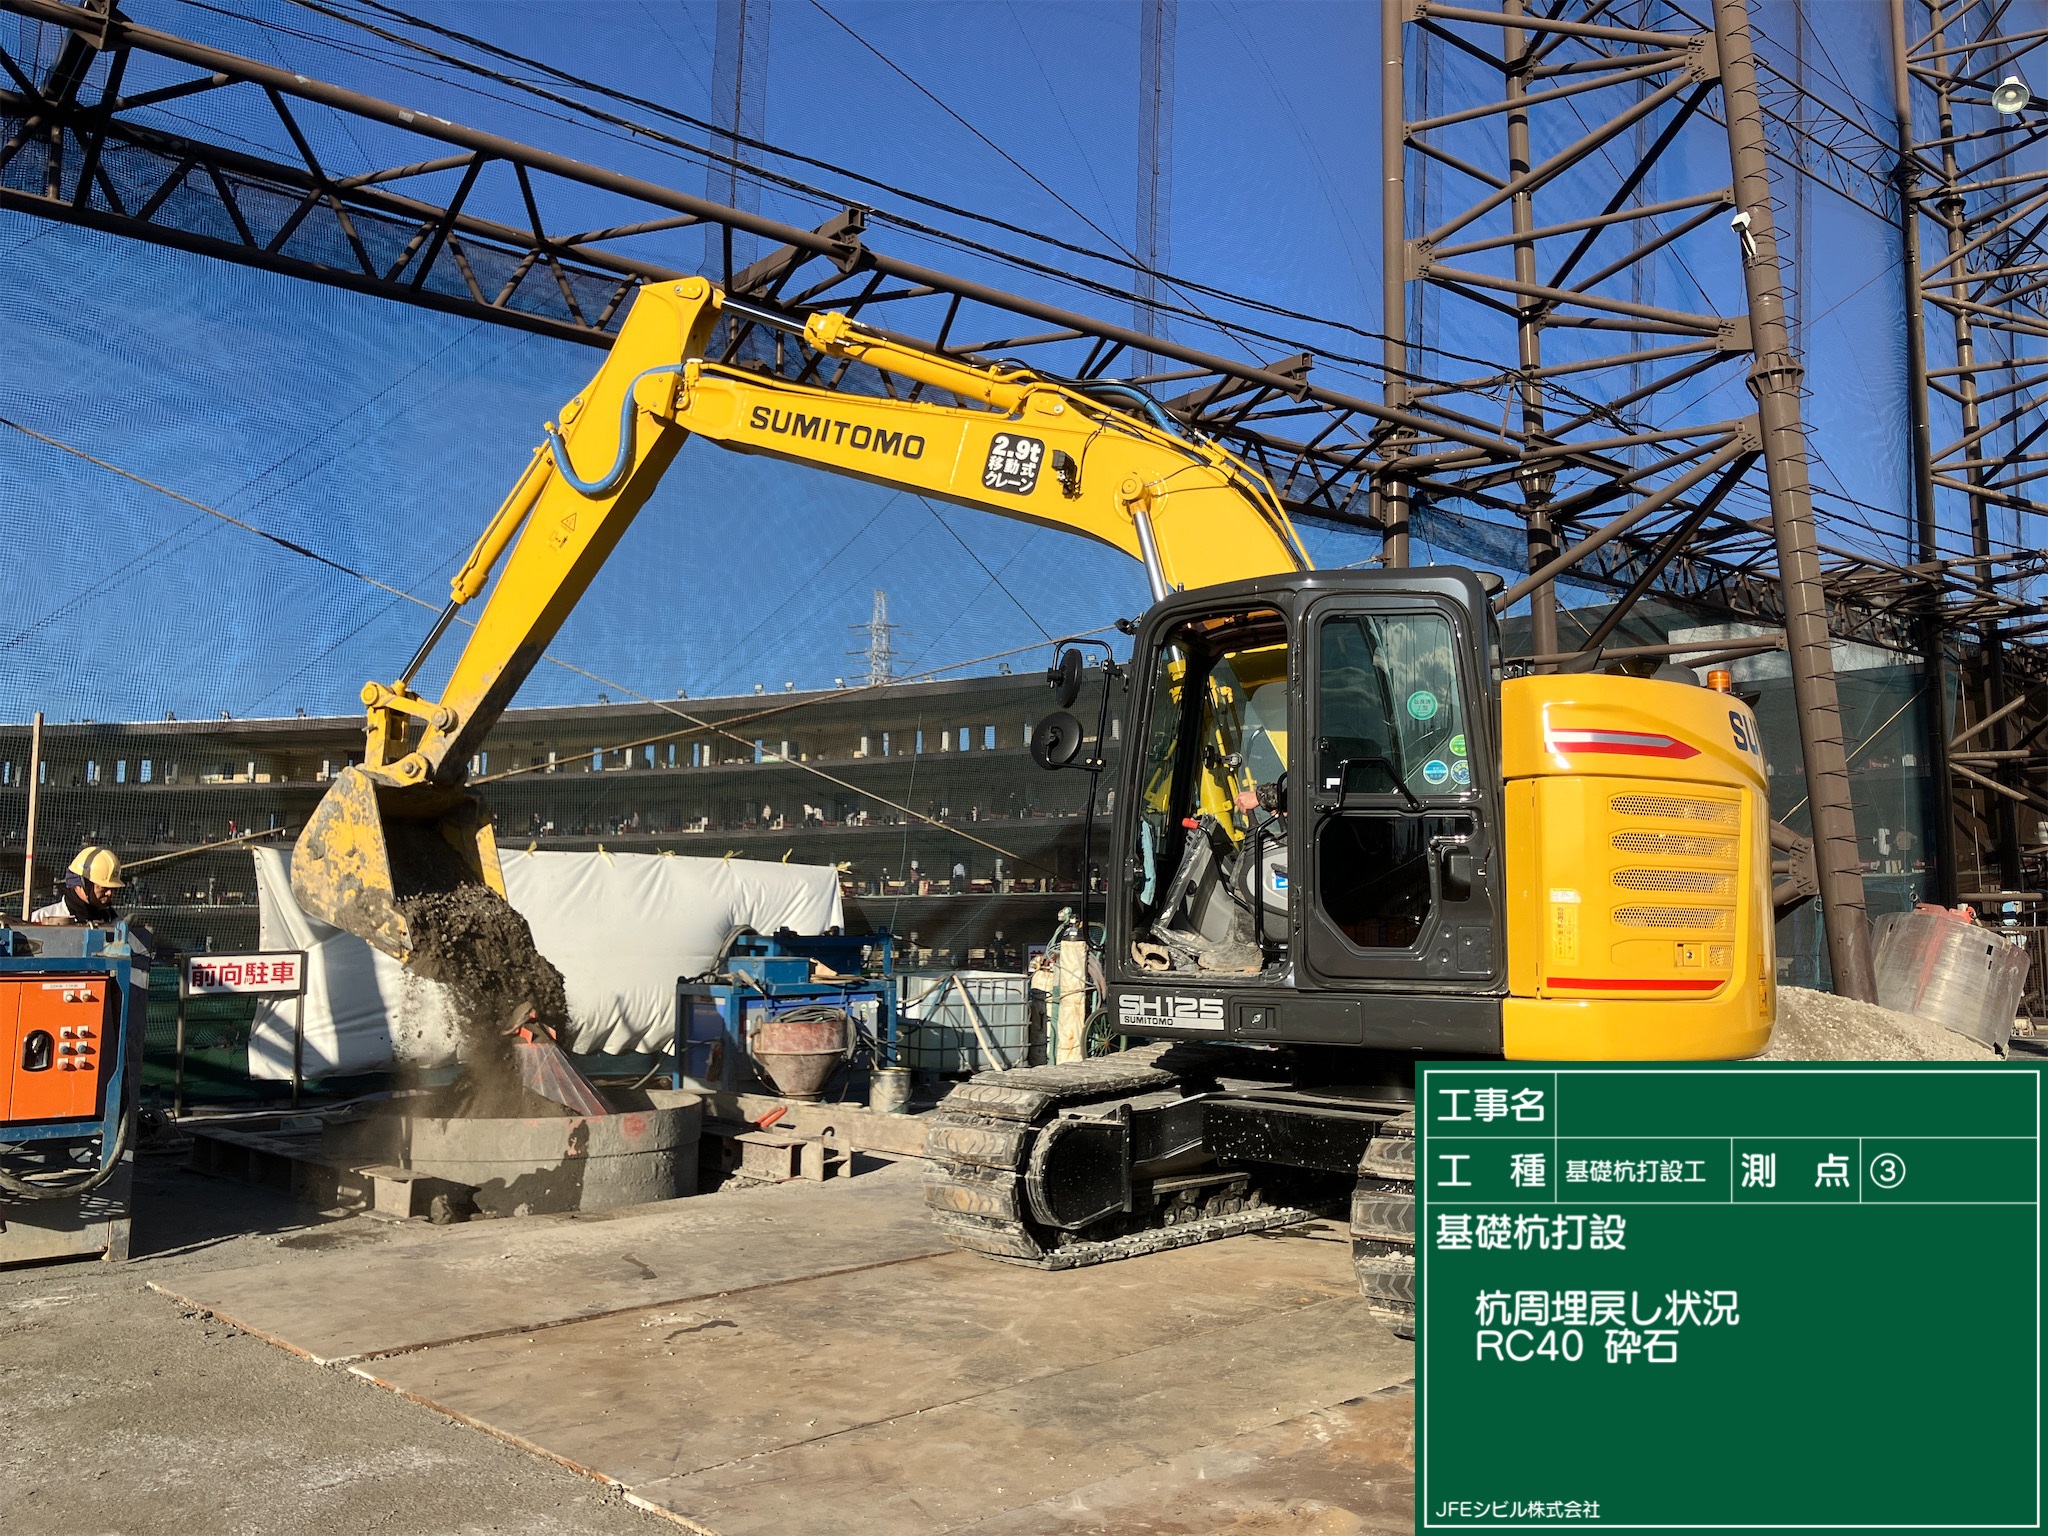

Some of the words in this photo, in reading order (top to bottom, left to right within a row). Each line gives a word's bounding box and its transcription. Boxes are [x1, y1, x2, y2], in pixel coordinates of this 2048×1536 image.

[750, 405, 926, 460] SUMITOMO
[992, 435, 1041, 463] 2.9t
[988, 455, 1037, 478] 移動式
[985, 471, 1034, 492] クレーン
[191, 960, 295, 987] 前向駐車
[1118, 994, 1224, 1020] SH125
[1124, 1016, 1174, 1026] SUMITOMO
